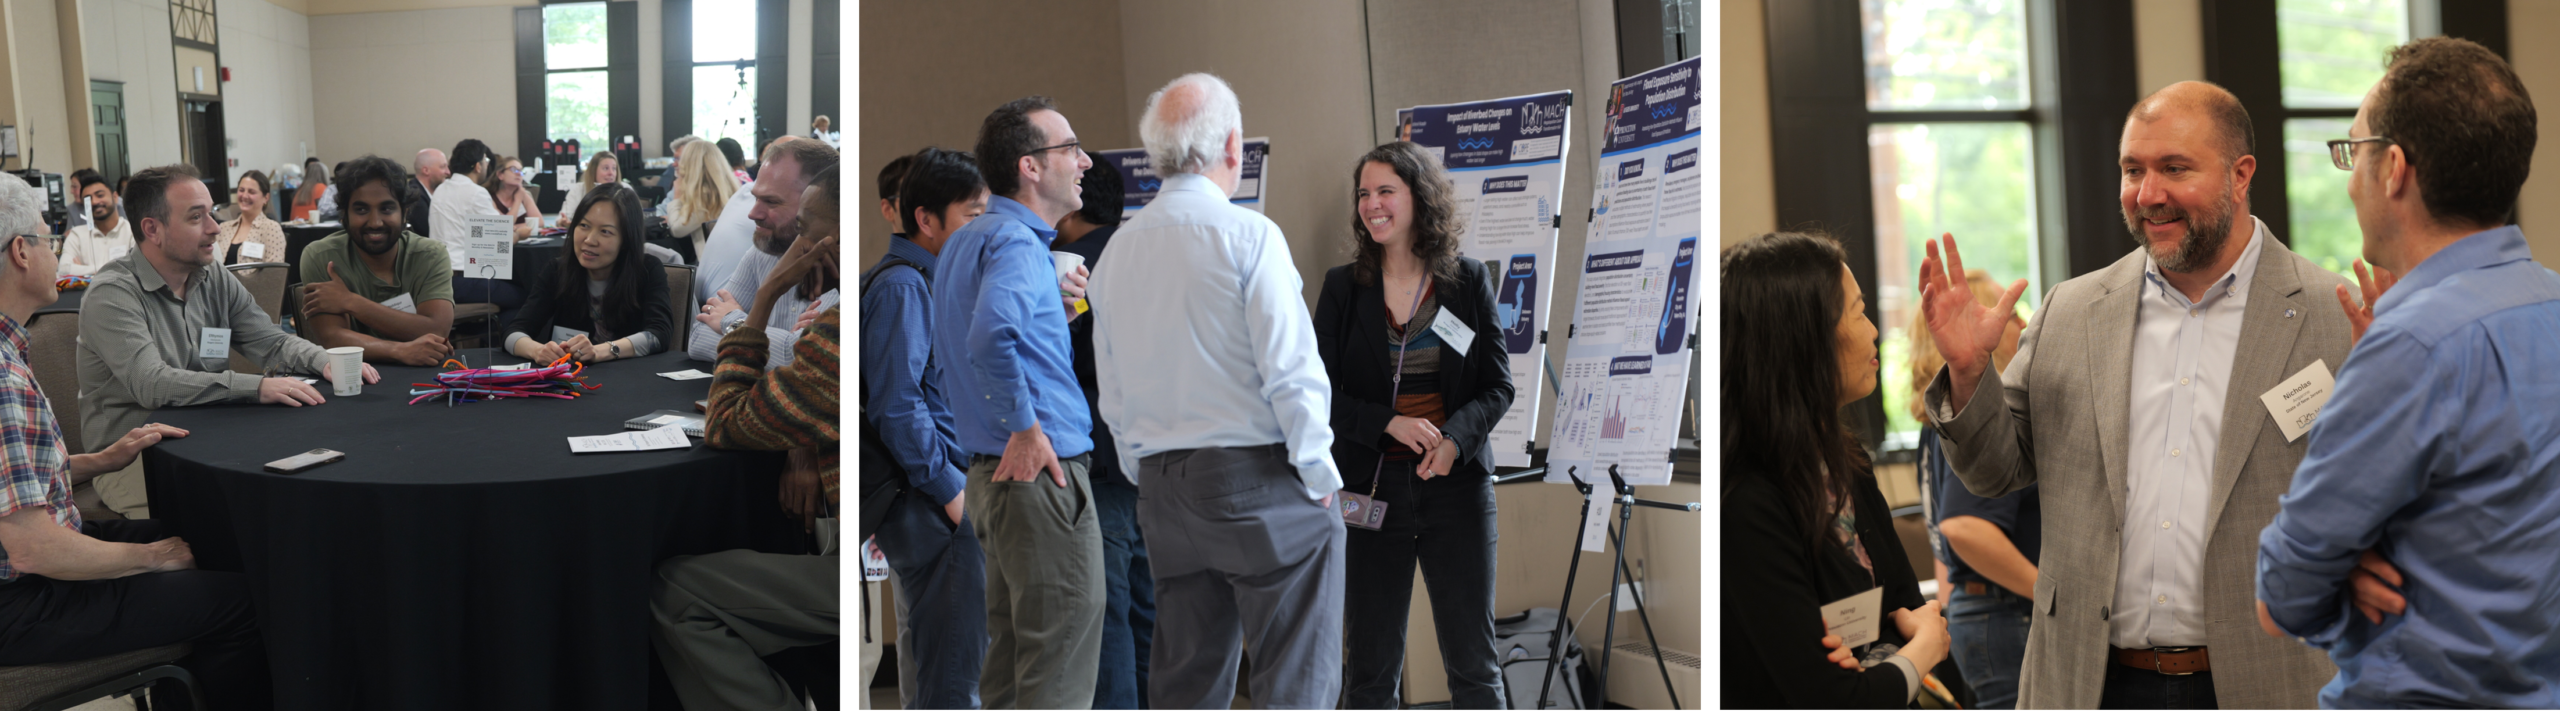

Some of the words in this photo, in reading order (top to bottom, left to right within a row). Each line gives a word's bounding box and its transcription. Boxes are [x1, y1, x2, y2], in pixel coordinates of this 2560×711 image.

[1447, 112, 1464, 124] Impact
[1468, 109, 1488, 120] Riverbed
[1488, 108, 1506, 120] Changes
[1506, 108, 1512, 116] on
[1544, 102, 1566, 119] MACH
[1456, 124, 1472, 135] Estuary
[1472, 123, 1488, 132] Water
[1488, 121, 1500, 131] Levels
[1122, 156, 1142, 167] Drivers
[1133, 167, 1142, 177] the
[1513, 261, 1524, 272] Project
[2283, 380, 2312, 400] Nicholas
[2286, 405, 2296, 414] State
[2310, 389, 2323, 399] Jersey
[1840, 607, 1856, 616] Ning
